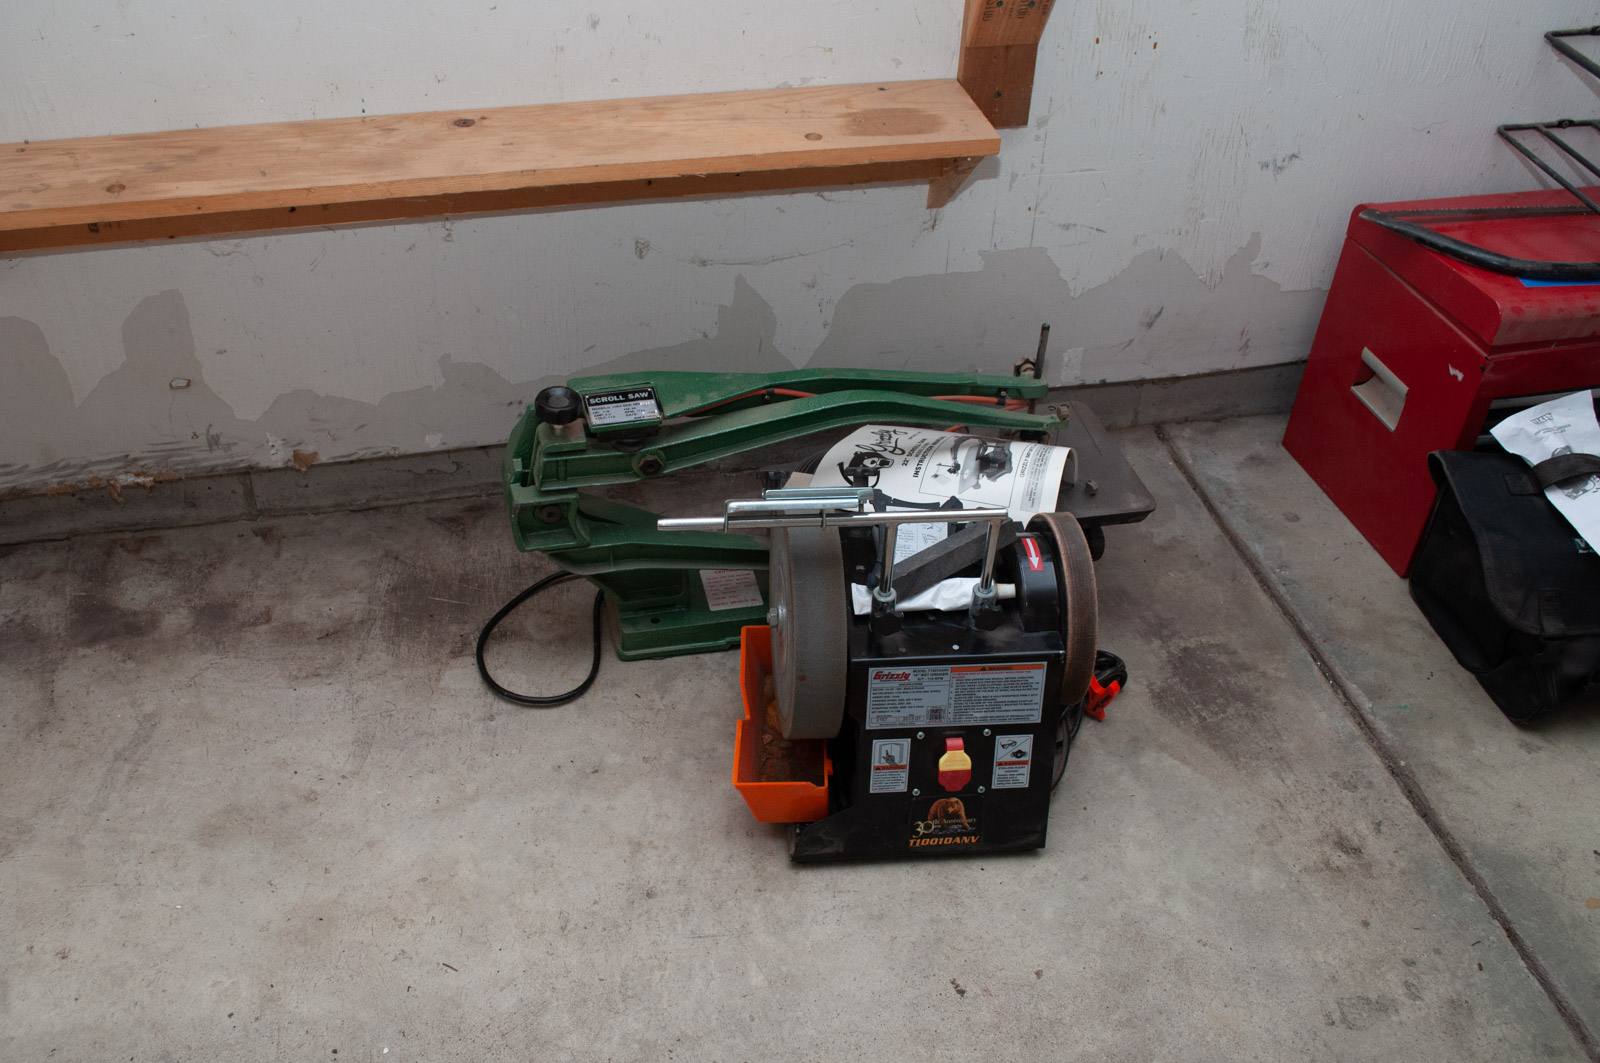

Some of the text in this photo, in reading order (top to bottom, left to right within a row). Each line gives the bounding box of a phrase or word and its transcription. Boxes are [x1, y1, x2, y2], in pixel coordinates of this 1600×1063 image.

[589, 392, 649, 404] SCROLL SAW
[912, 443, 935, 478] INSTRUCTION
[873, 670, 911, 681] Grizzly
[908, 836, 980, 847] T10010ANV
